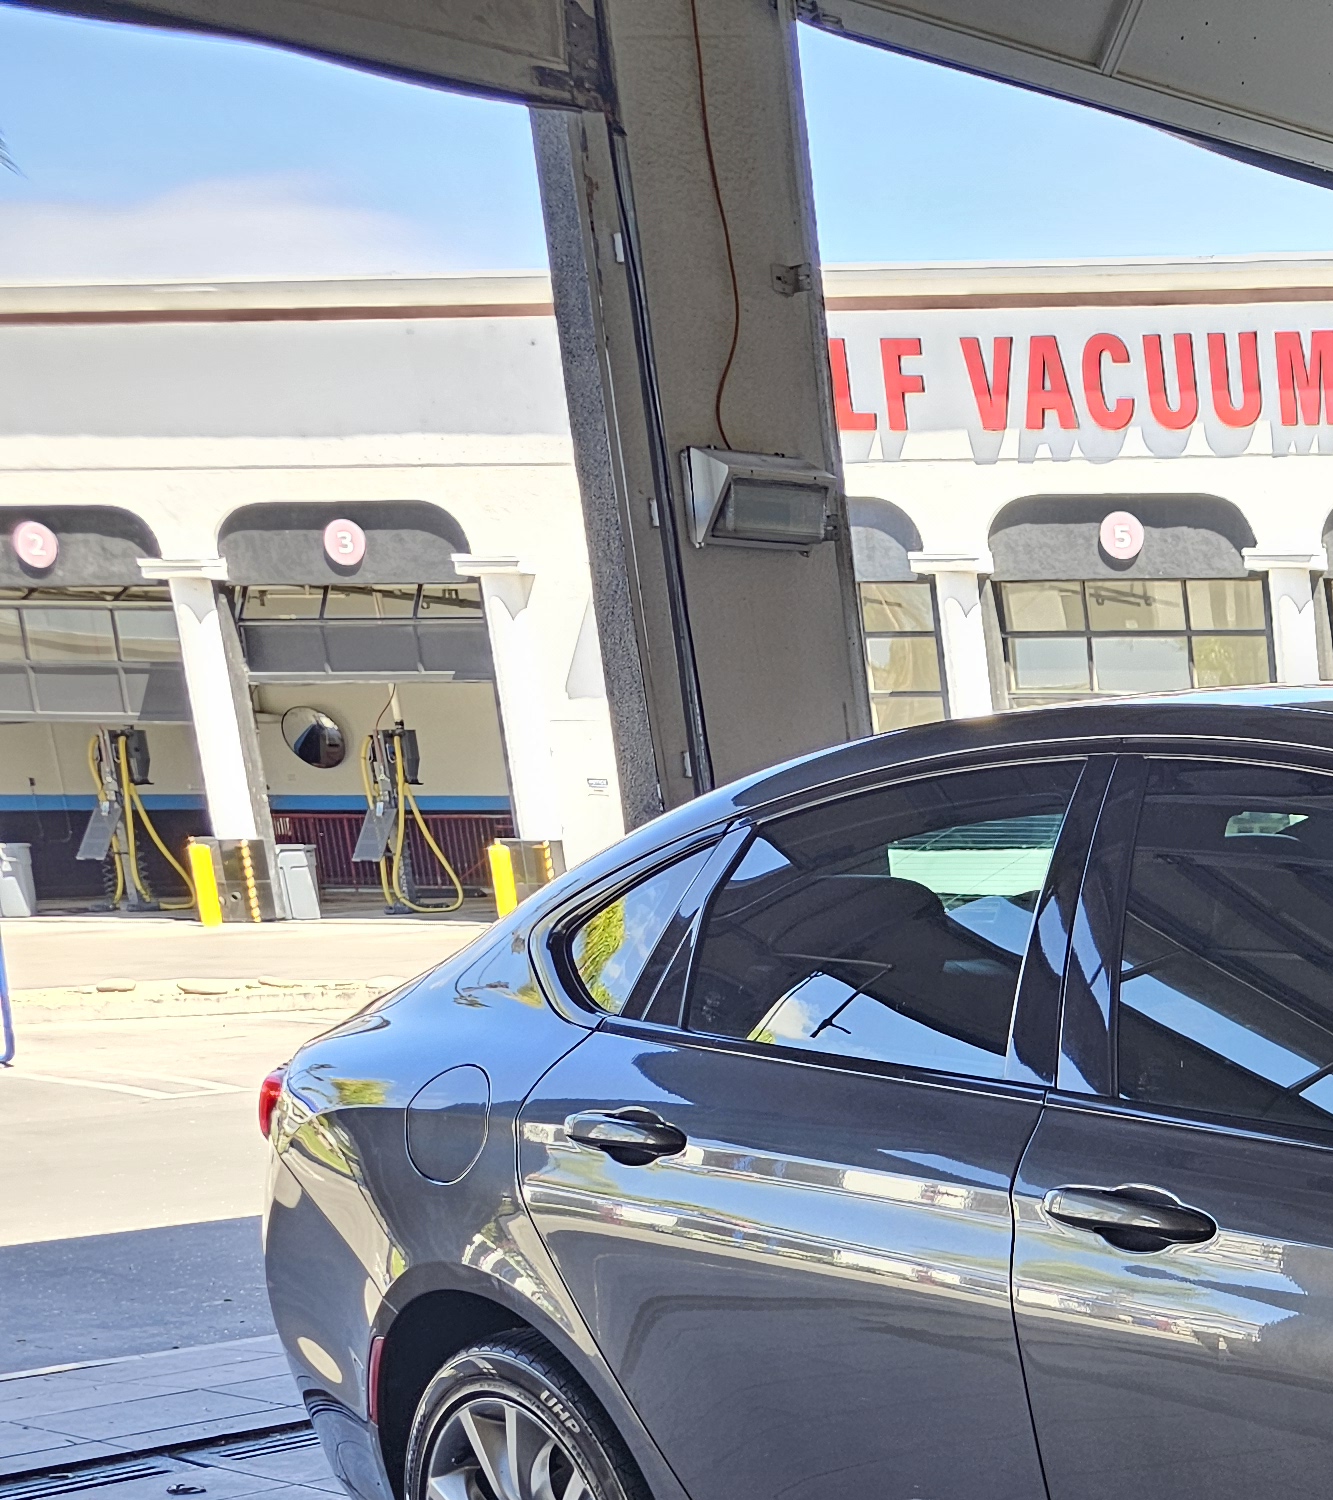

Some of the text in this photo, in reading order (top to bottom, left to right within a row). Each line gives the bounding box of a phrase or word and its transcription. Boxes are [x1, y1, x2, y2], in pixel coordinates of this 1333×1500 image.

[27, 532, 47, 556] 2
[336, 530, 354, 554] 3
[1114, 524, 1132, 548] 5
[539, 1389, 581, 1434] UHP
